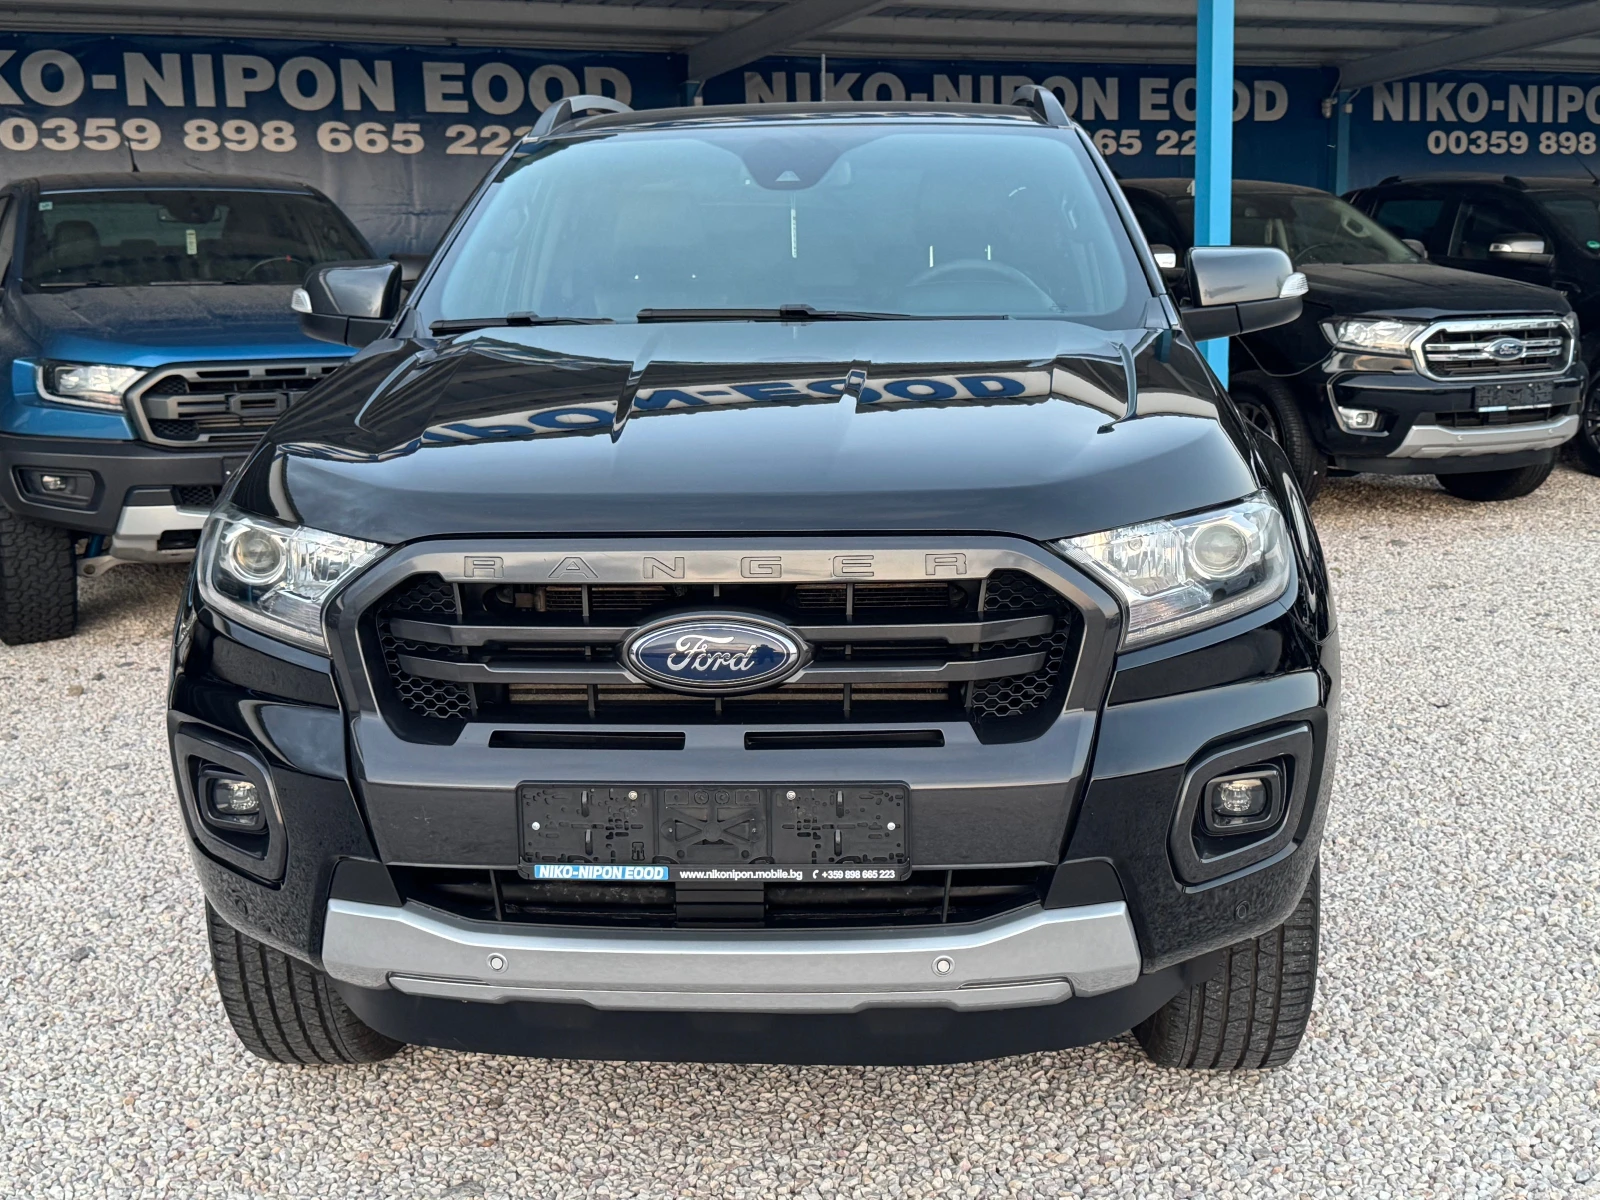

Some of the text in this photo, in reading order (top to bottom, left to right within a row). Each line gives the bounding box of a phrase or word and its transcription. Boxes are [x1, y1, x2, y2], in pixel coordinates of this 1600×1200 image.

[183, 119, 298, 153] 898
[316, 120, 425, 154] 665
[1427, 130, 1597, 155] 00359 898
[464, 553, 967, 579] RANGER
[666, 634, 757, 671] Ford
[539, 864, 896, 881] NIKO-NIPON EOOD www.nikonipon.mobile.bg +359 898 665 223
